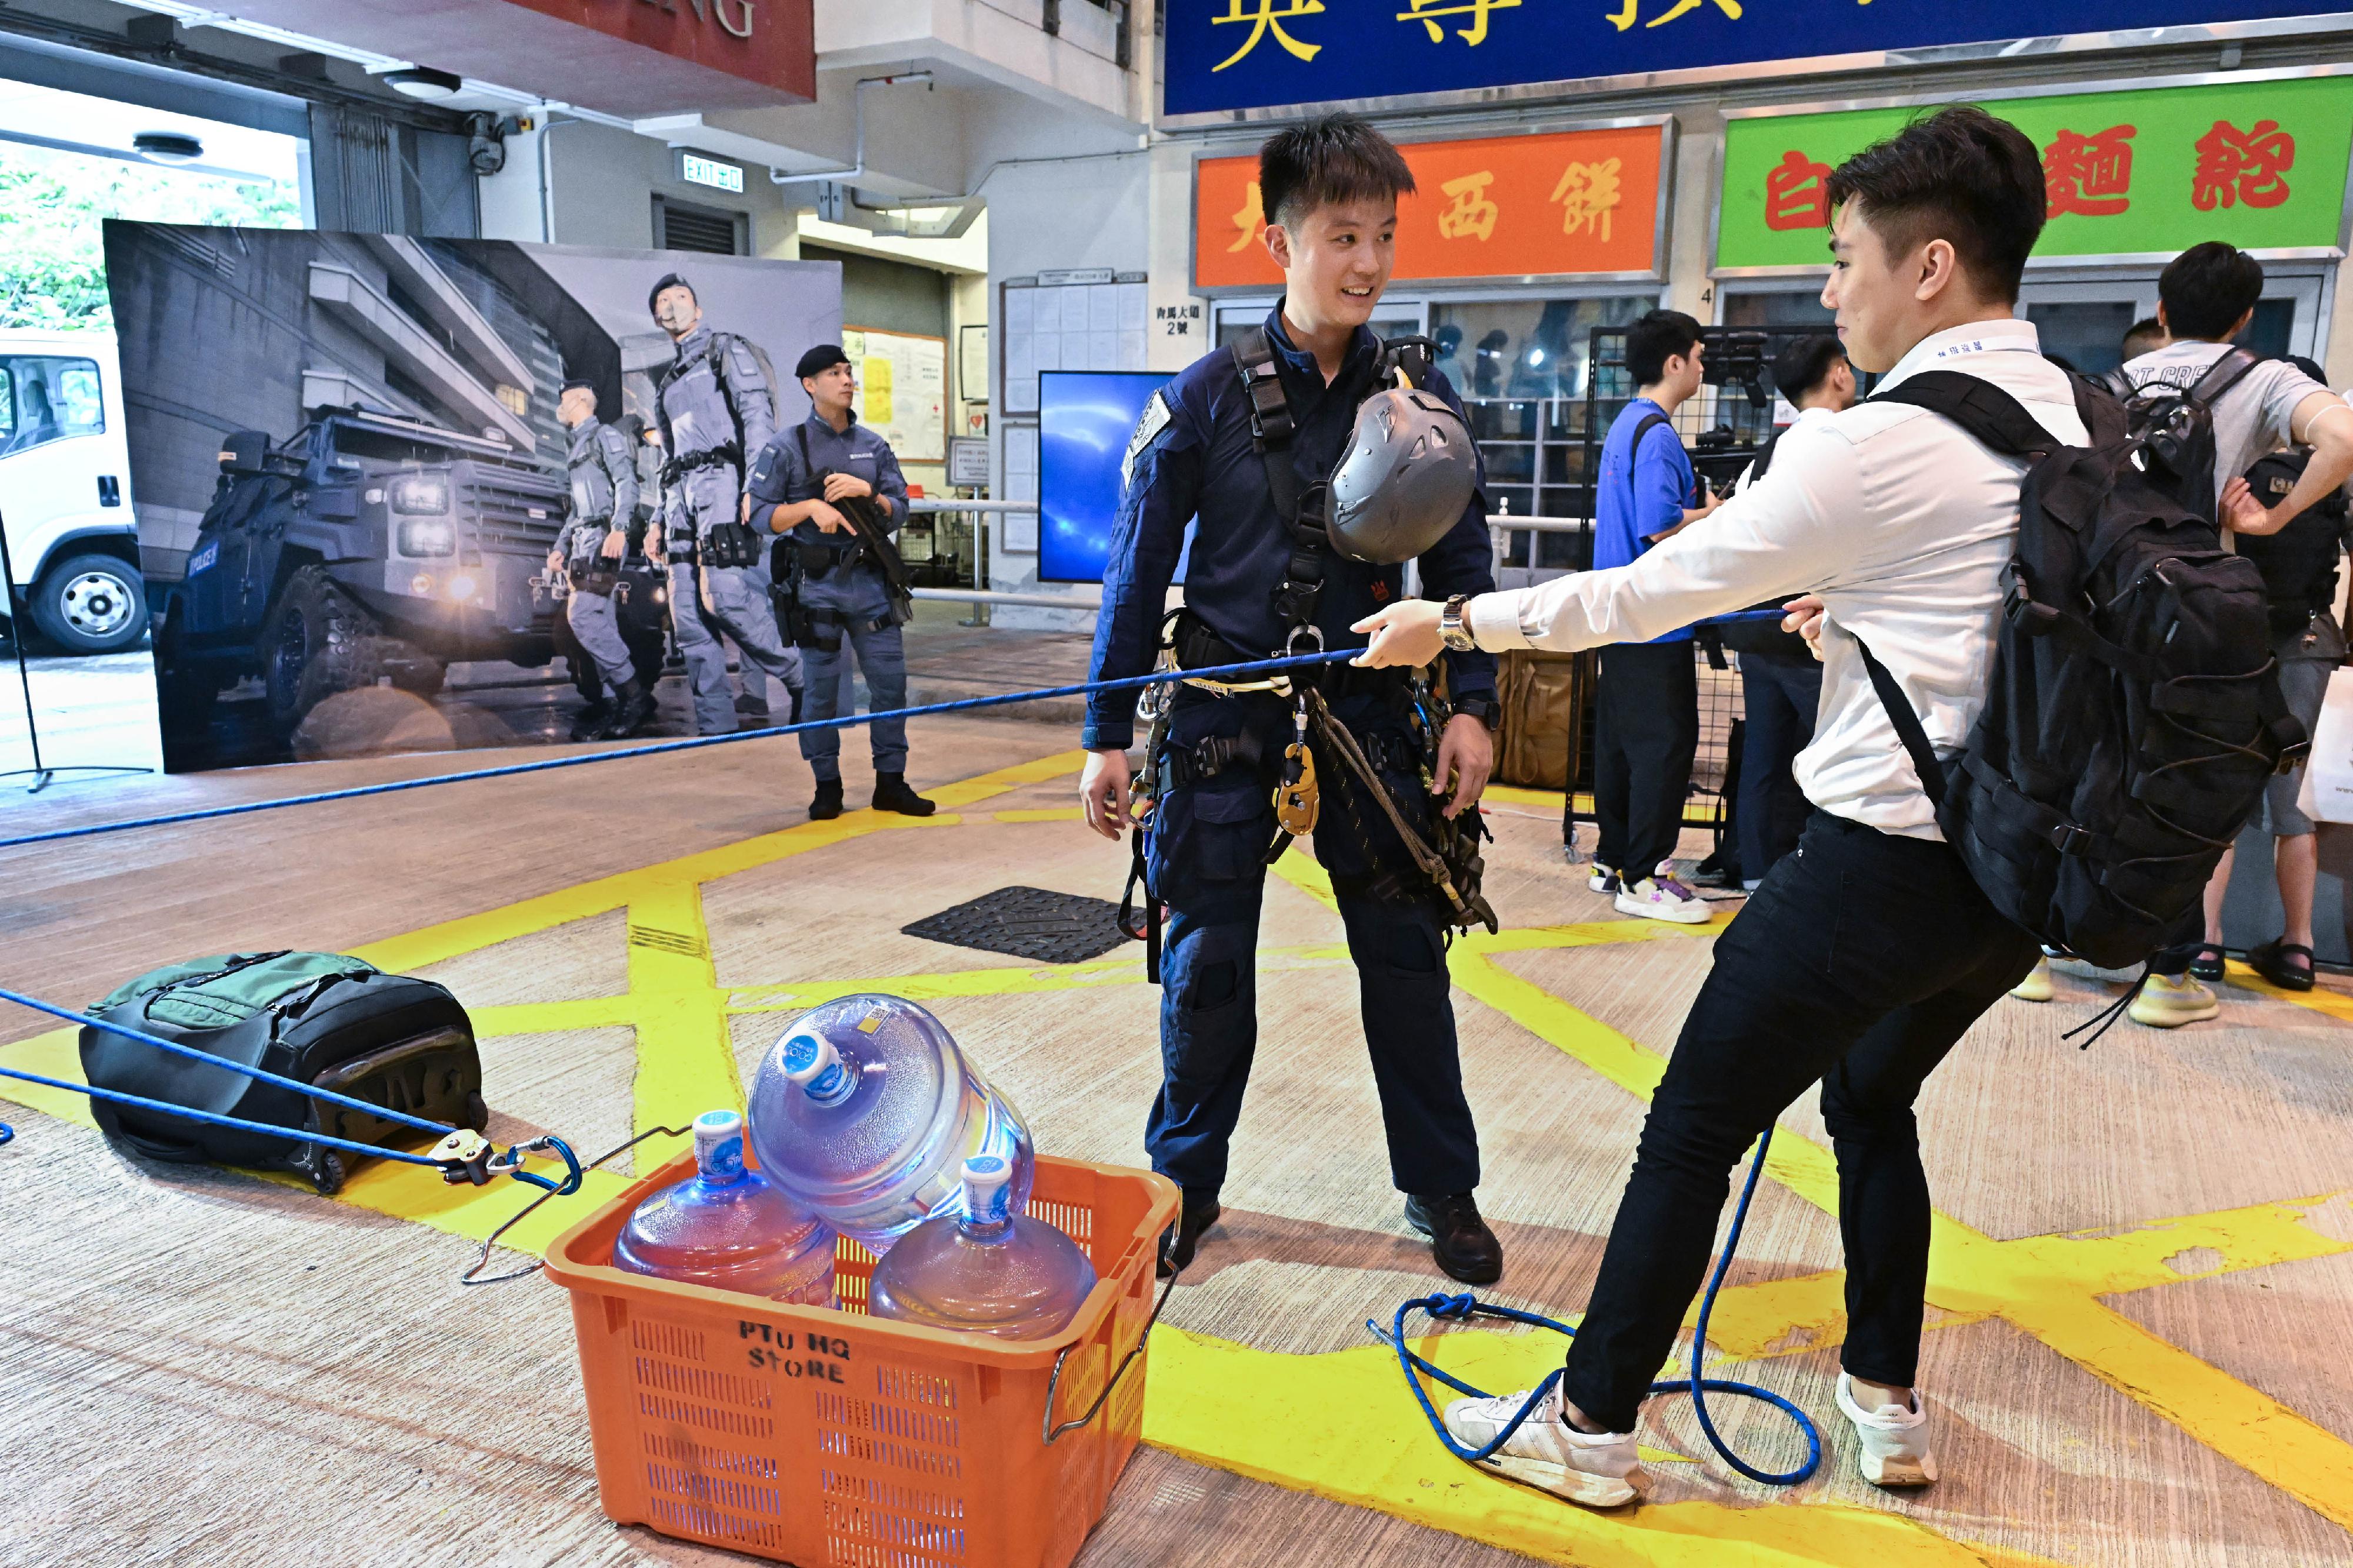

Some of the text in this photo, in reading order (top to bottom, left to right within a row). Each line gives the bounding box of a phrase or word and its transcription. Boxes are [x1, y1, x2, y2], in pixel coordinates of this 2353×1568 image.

[687, 159, 714, 183] EXIT
[718, 167, 739, 189] 出口
[1701, 288, 1712, 304] 4
[740, 1320, 850, 1360] PTU HQ
[748, 1346, 845, 1384] STORE
